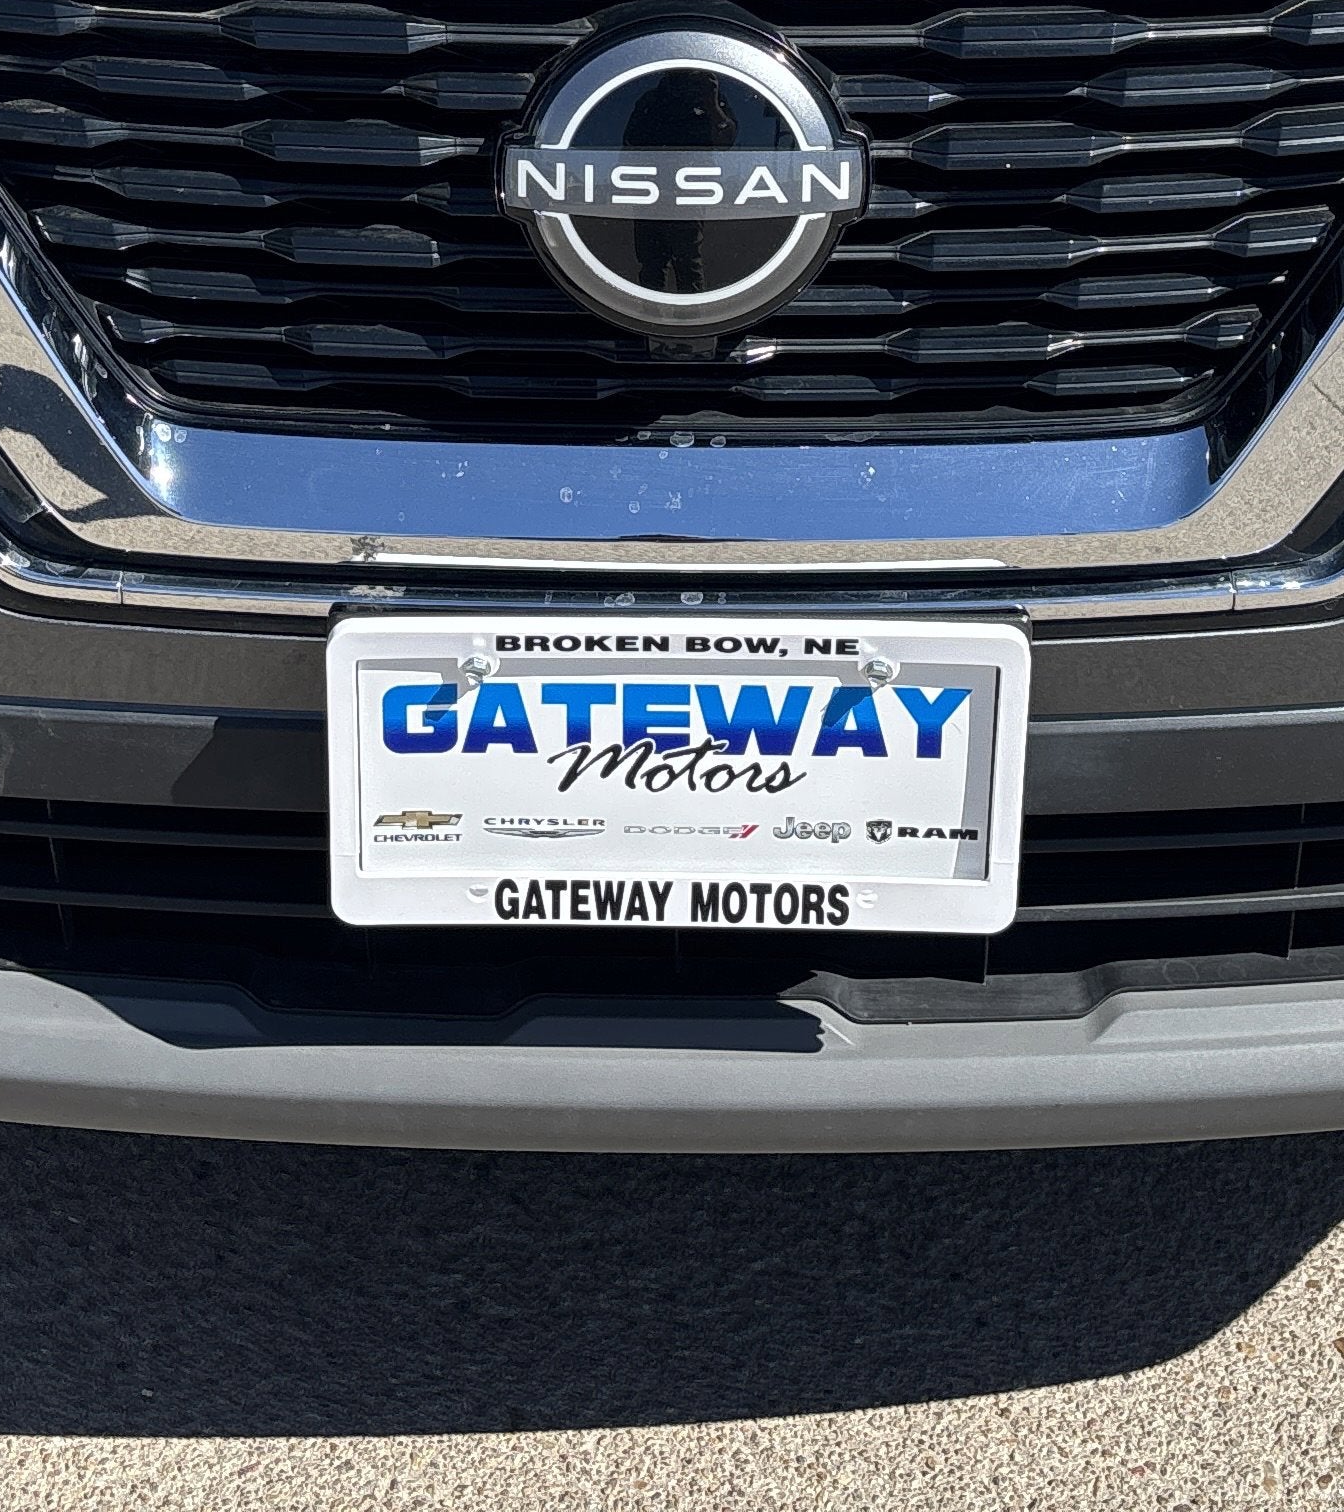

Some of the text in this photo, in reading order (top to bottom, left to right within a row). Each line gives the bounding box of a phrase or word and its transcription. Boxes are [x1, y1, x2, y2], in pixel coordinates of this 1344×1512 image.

[516, 159, 850, 205] NISSAN
[495, 635, 860, 659] BROKEN BOW, NE
[382, 681, 974, 760] GATEWAY
[547, 737, 808, 795] Motors
[484, 817, 606, 826] CHRYSLER
[624, 825, 740, 835] DODGE
[772, 816, 852, 843] Jeep
[897, 826, 979, 841] RAM
[373, 833, 463, 843] CHEVROLET
[494, 879, 851, 928] GATEWAY MOTORS
